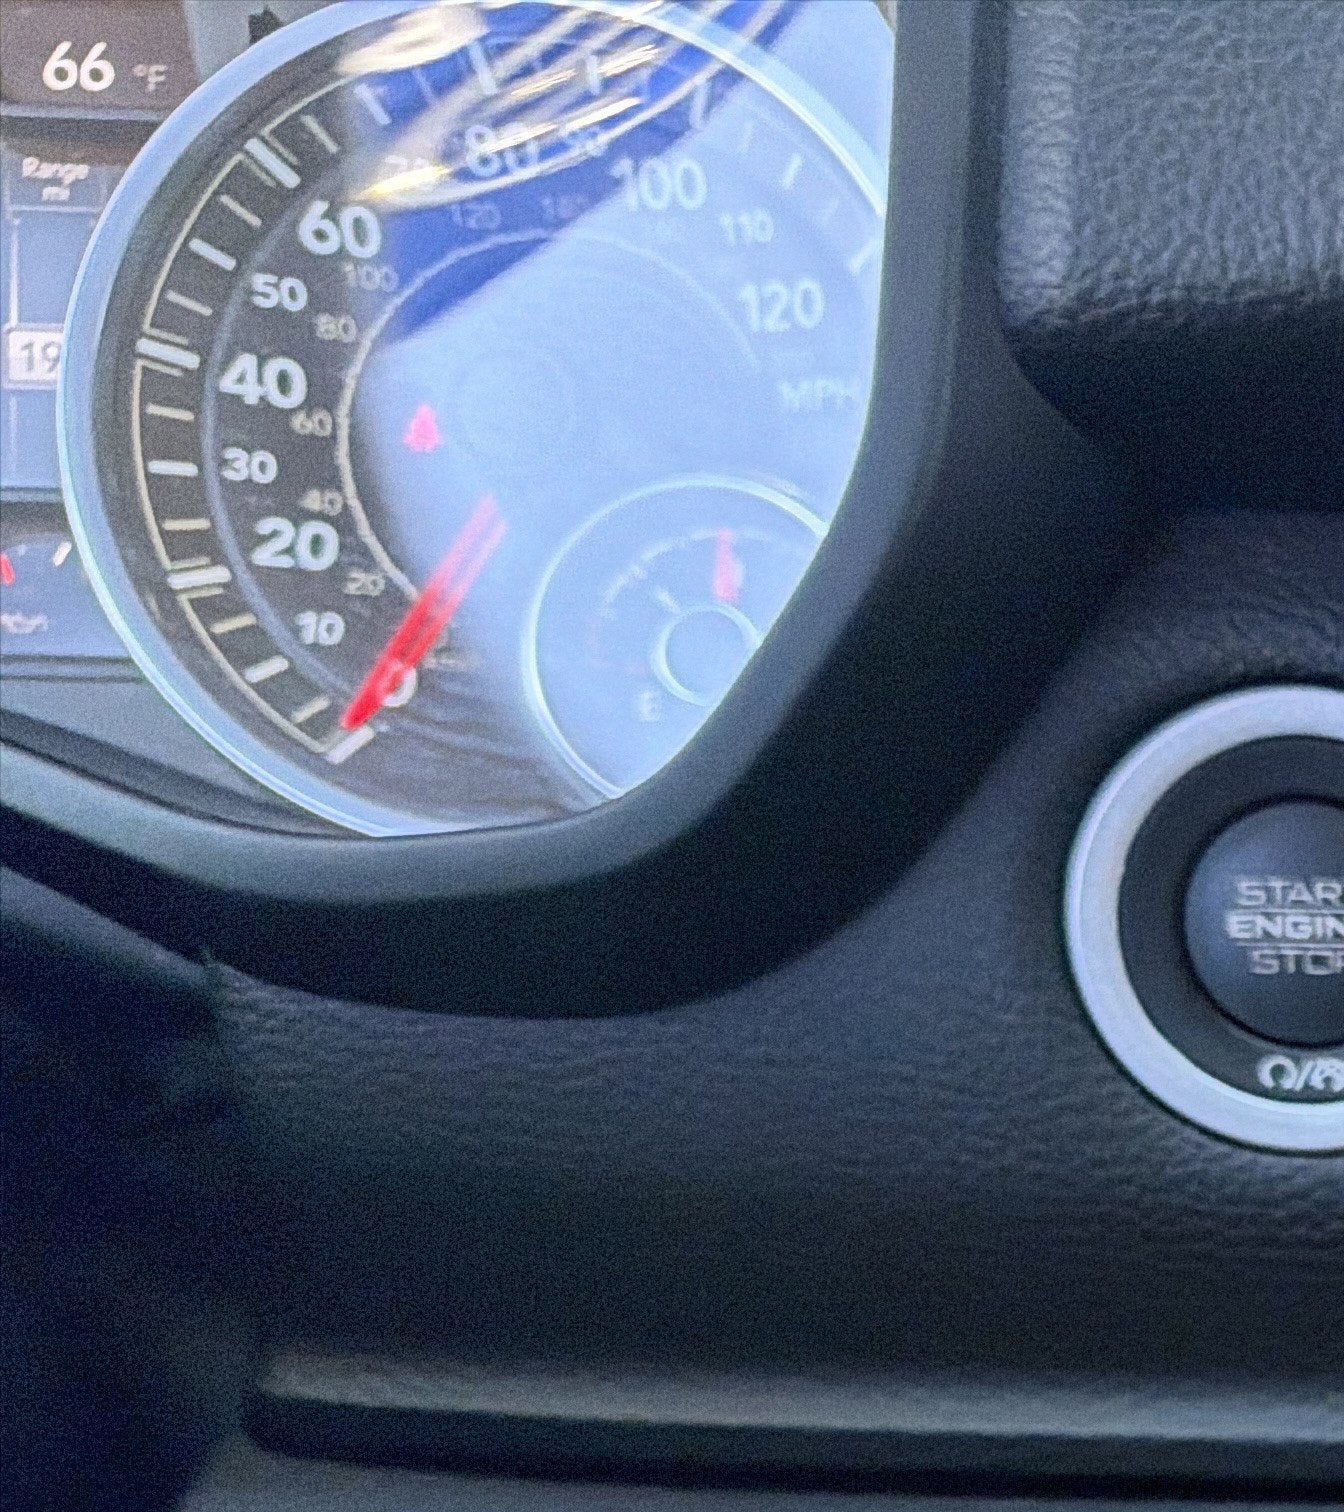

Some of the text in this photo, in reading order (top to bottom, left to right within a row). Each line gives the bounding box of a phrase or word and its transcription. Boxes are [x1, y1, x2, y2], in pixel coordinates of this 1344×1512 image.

[42, 41, 115, 91] 66
[299, 202, 382, 259] 60
[718, 211, 775, 246] 110
[250, 273, 309, 313] 50
[341, 263, 399, 293] 100
[737, 278, 825, 333] 120
[314, 312, 358, 343] 80
[218, 352, 308, 409] 40
[220, 447, 278, 484] 30
[301, 488, 345, 516] 40
[251, 516, 340, 571] 20
[345, 568, 387, 597] 20
[294, 611, 346, 647] 10
